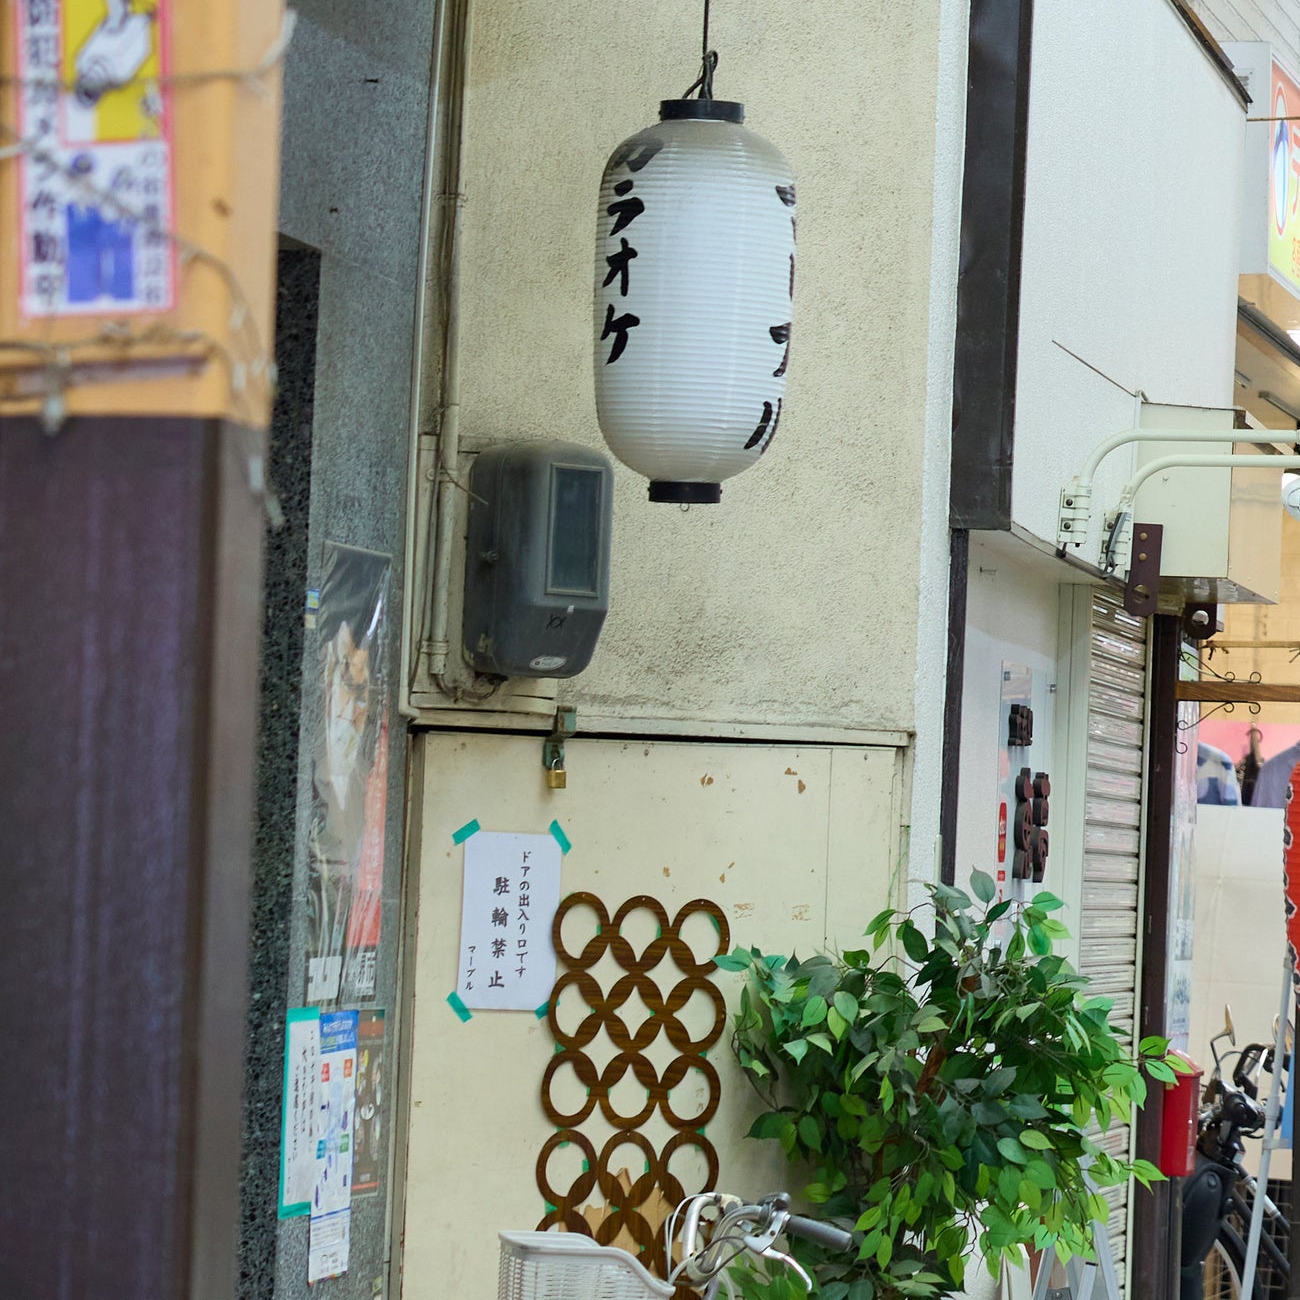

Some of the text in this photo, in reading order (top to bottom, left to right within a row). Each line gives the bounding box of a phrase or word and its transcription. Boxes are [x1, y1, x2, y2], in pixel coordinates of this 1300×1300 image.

[600, 137, 665, 364] カラオケ
[465, 945, 477, 991] マーブル
[487, 876, 510, 989] 駐輪禁止
[514, 851, 532, 979] ドアの出入り口です
